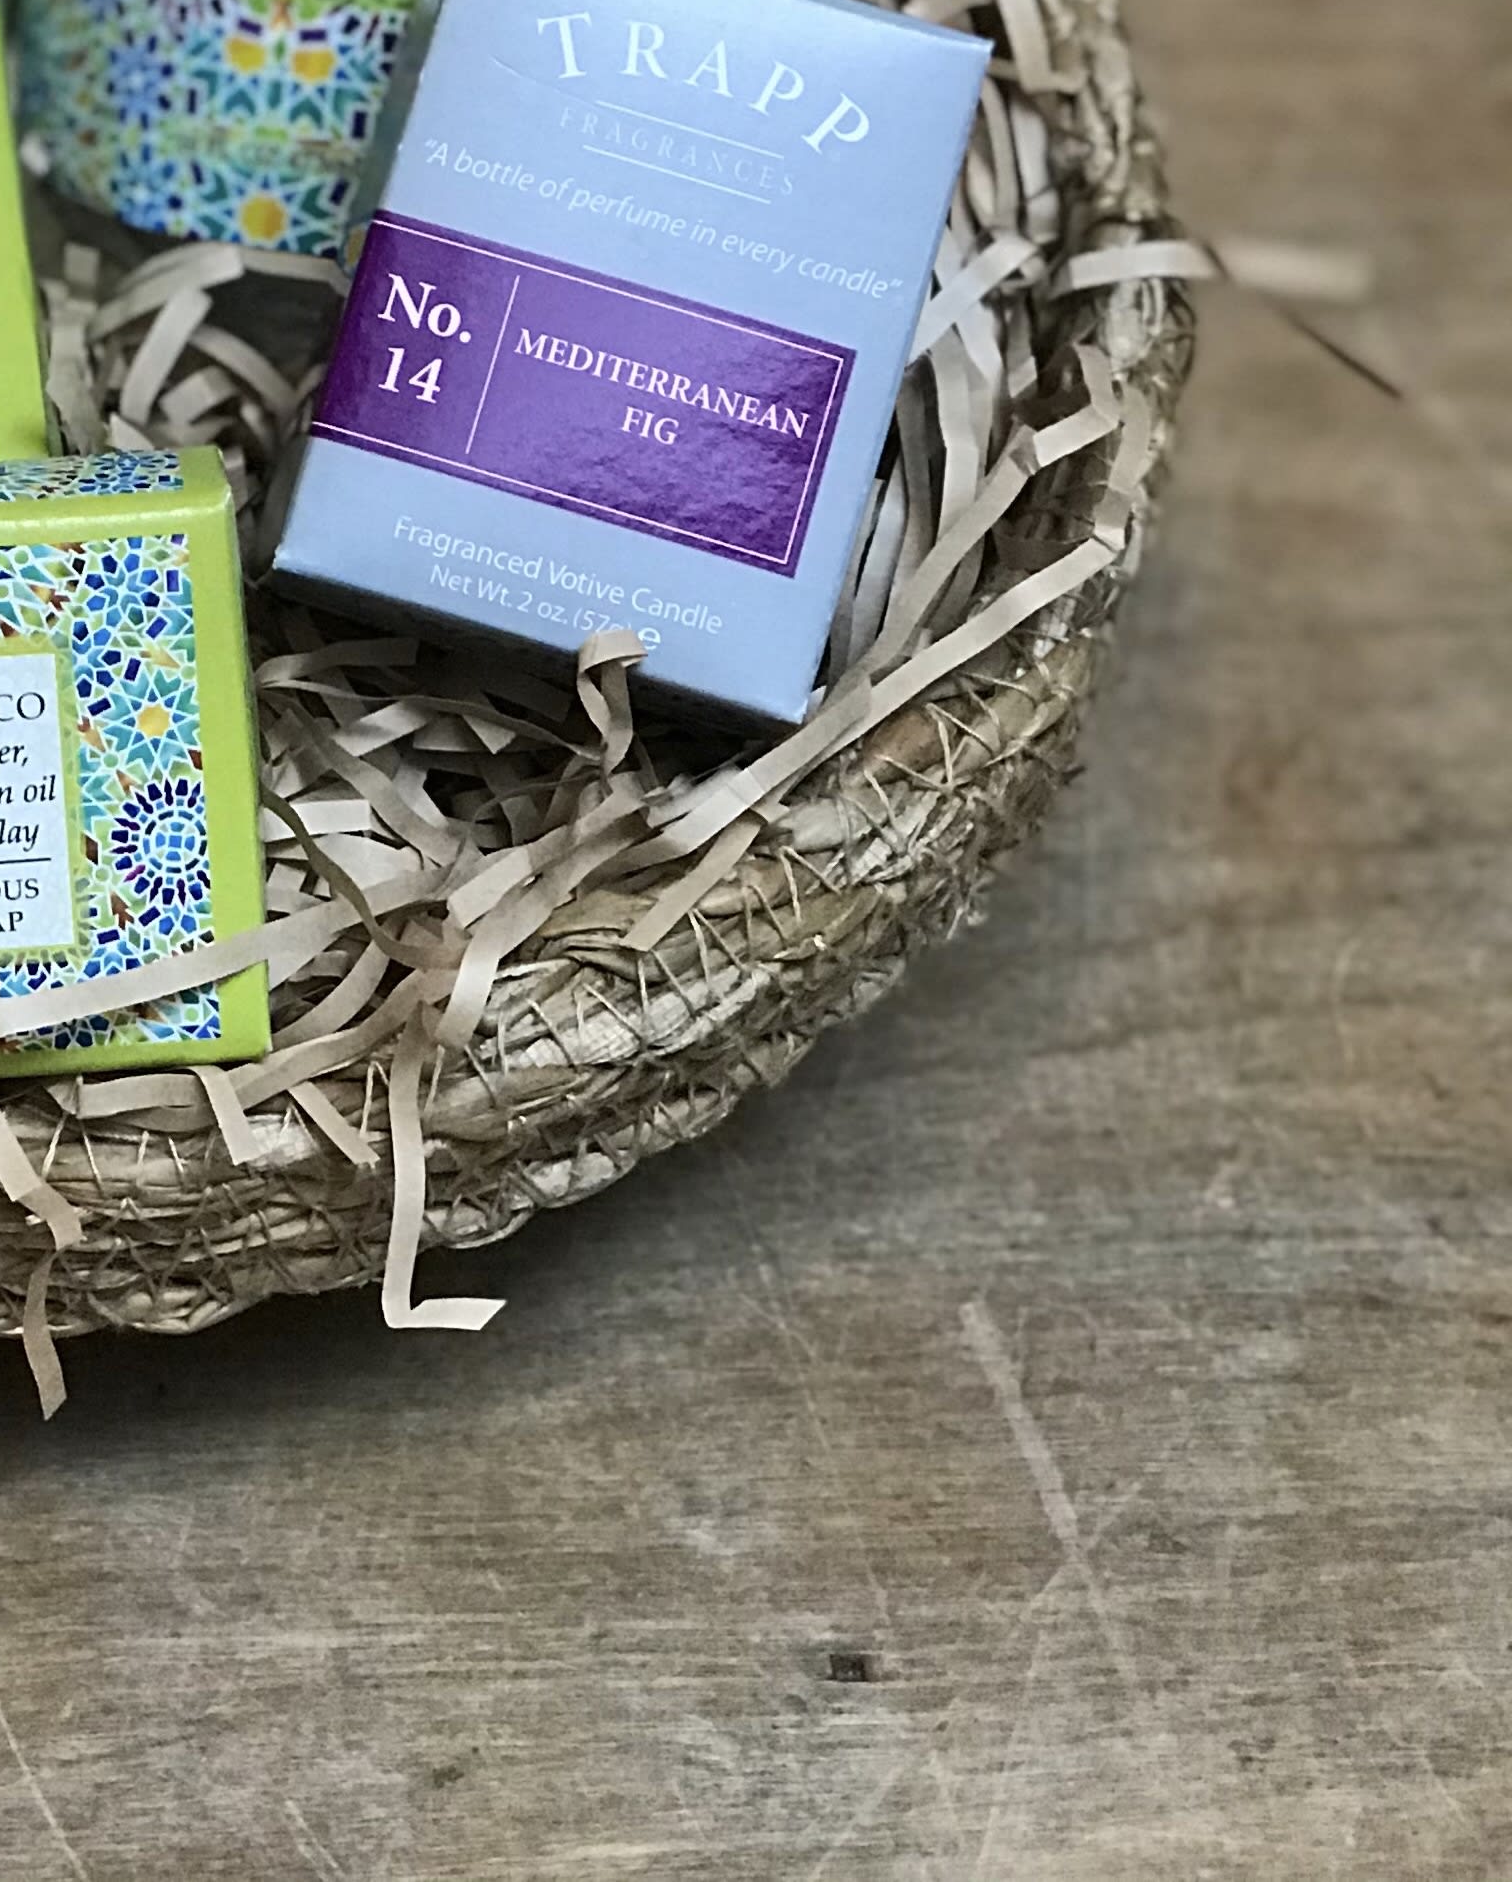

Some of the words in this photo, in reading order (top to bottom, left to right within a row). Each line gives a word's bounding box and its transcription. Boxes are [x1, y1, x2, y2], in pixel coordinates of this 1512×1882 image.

[537, 11, 872, 155] TRAPP
[559, 106, 793, 196] FRAGRANCES
[453, 147, 535, 191] bottle
[538, 177, 575, 201] of
[567, 188, 687, 238] perfume
[688, 218, 717, 246] in
[721, 234, 796, 274] every
[377, 273, 471, 344] No.
[377, 346, 442, 405] 14
[513, 328, 810, 440] MEDITERRANEAN
[621, 405, 680, 447] FIG
[392, 515, 544, 580] Fragranced
[548, 561, 625, 605] Votive
[631, 587, 724, 635] Candle
[430, 564, 473, 596] Net
[478, 578, 512, 608] Wt.
[517, 591, 533, 613] 2
[537, 600, 568, 624] oz.
[23, 775, 57, 803] oil
